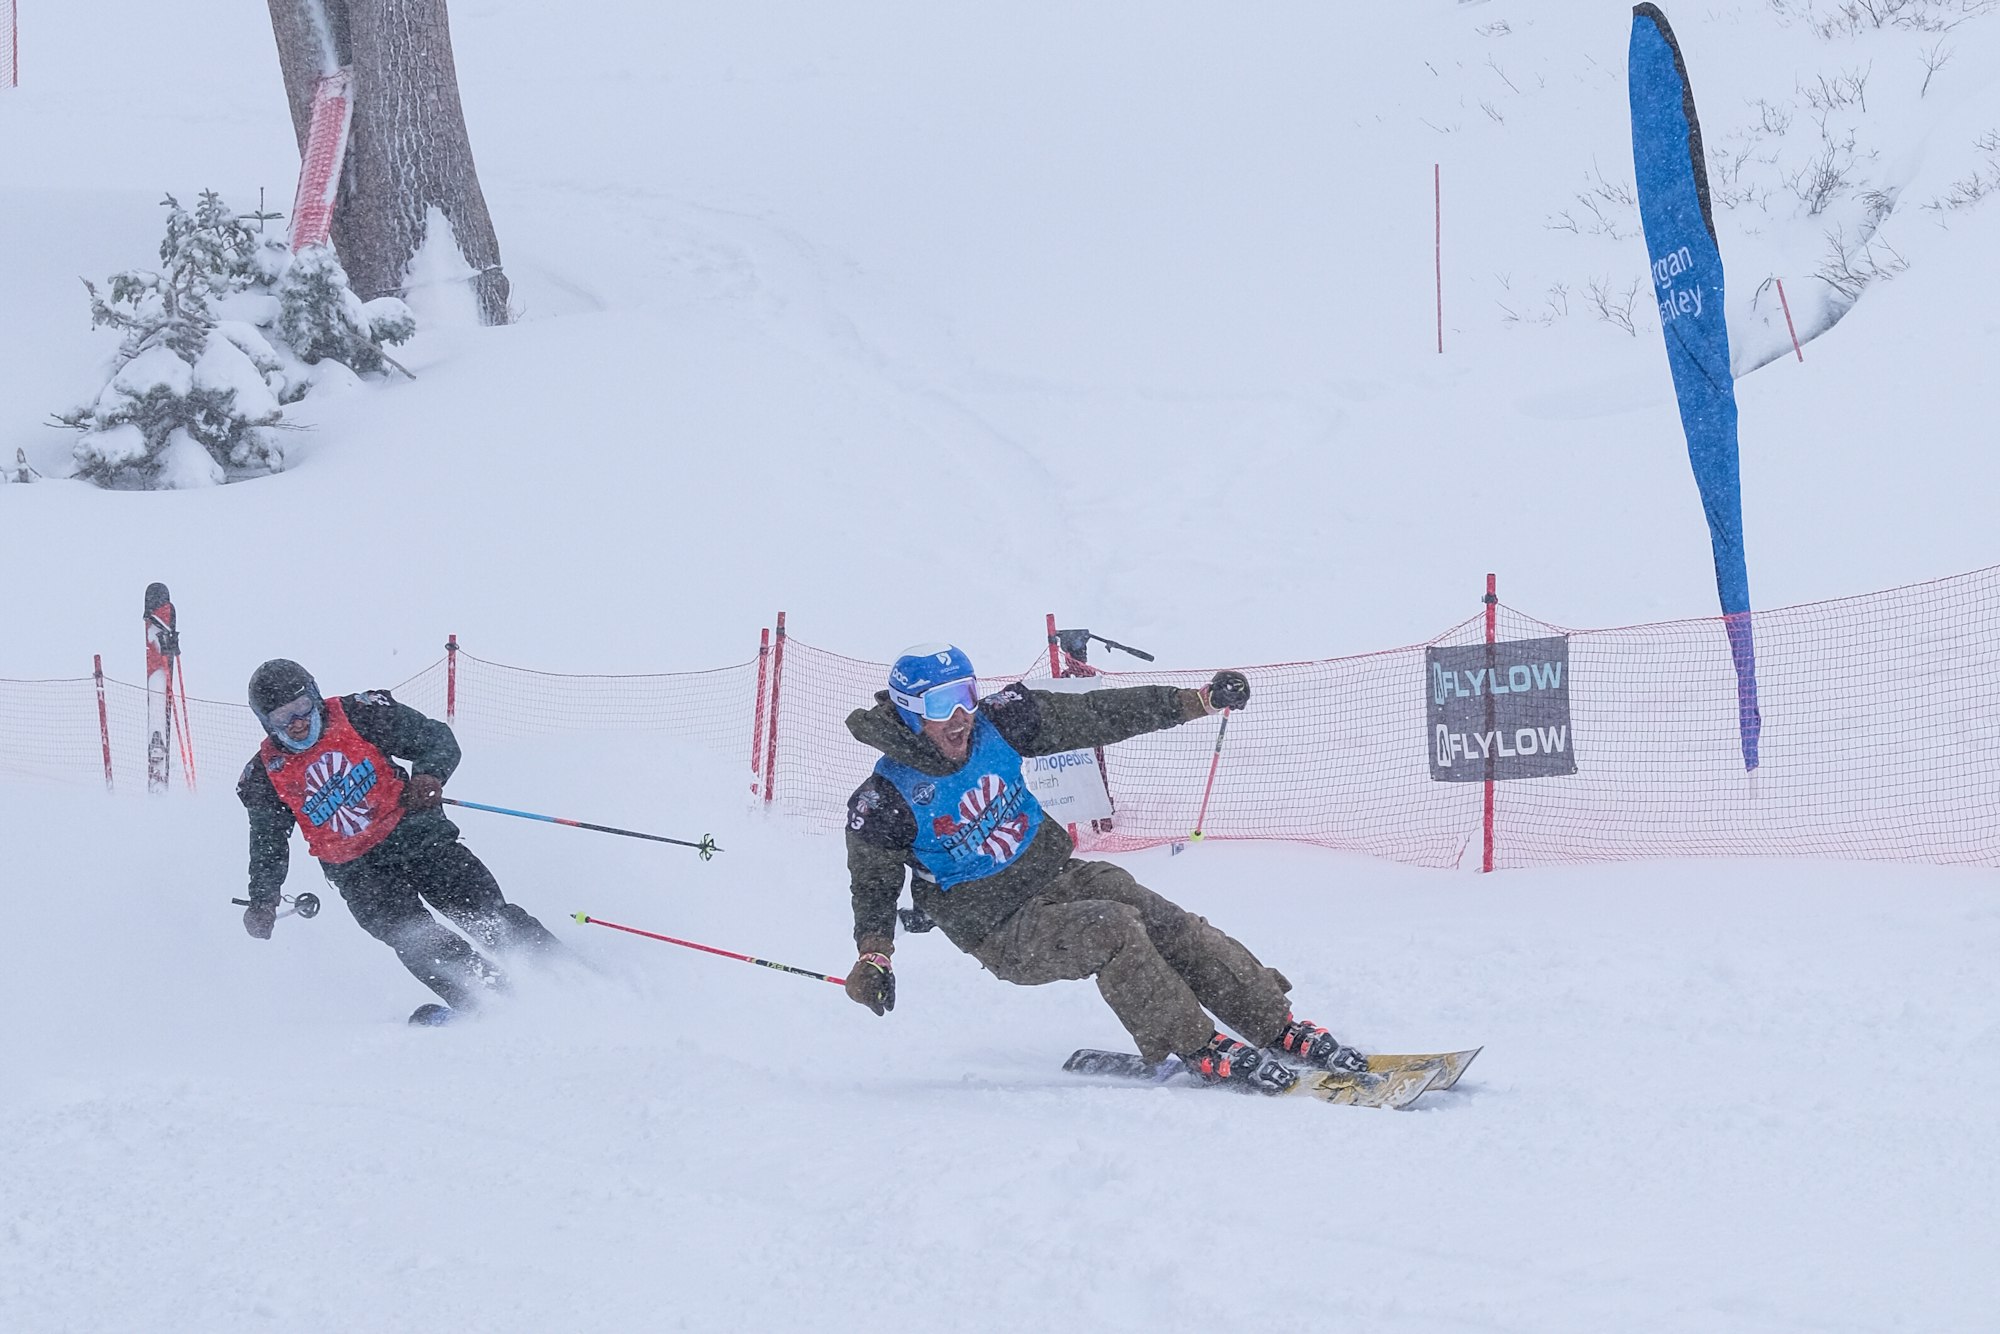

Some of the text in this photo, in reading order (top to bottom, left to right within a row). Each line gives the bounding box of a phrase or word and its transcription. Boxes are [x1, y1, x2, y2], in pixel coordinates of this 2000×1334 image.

[1442, 661, 1562, 699] FLYLOW
[1450, 724, 1567, 760] FLYLOW
[308, 756, 376, 828] BANZAI
